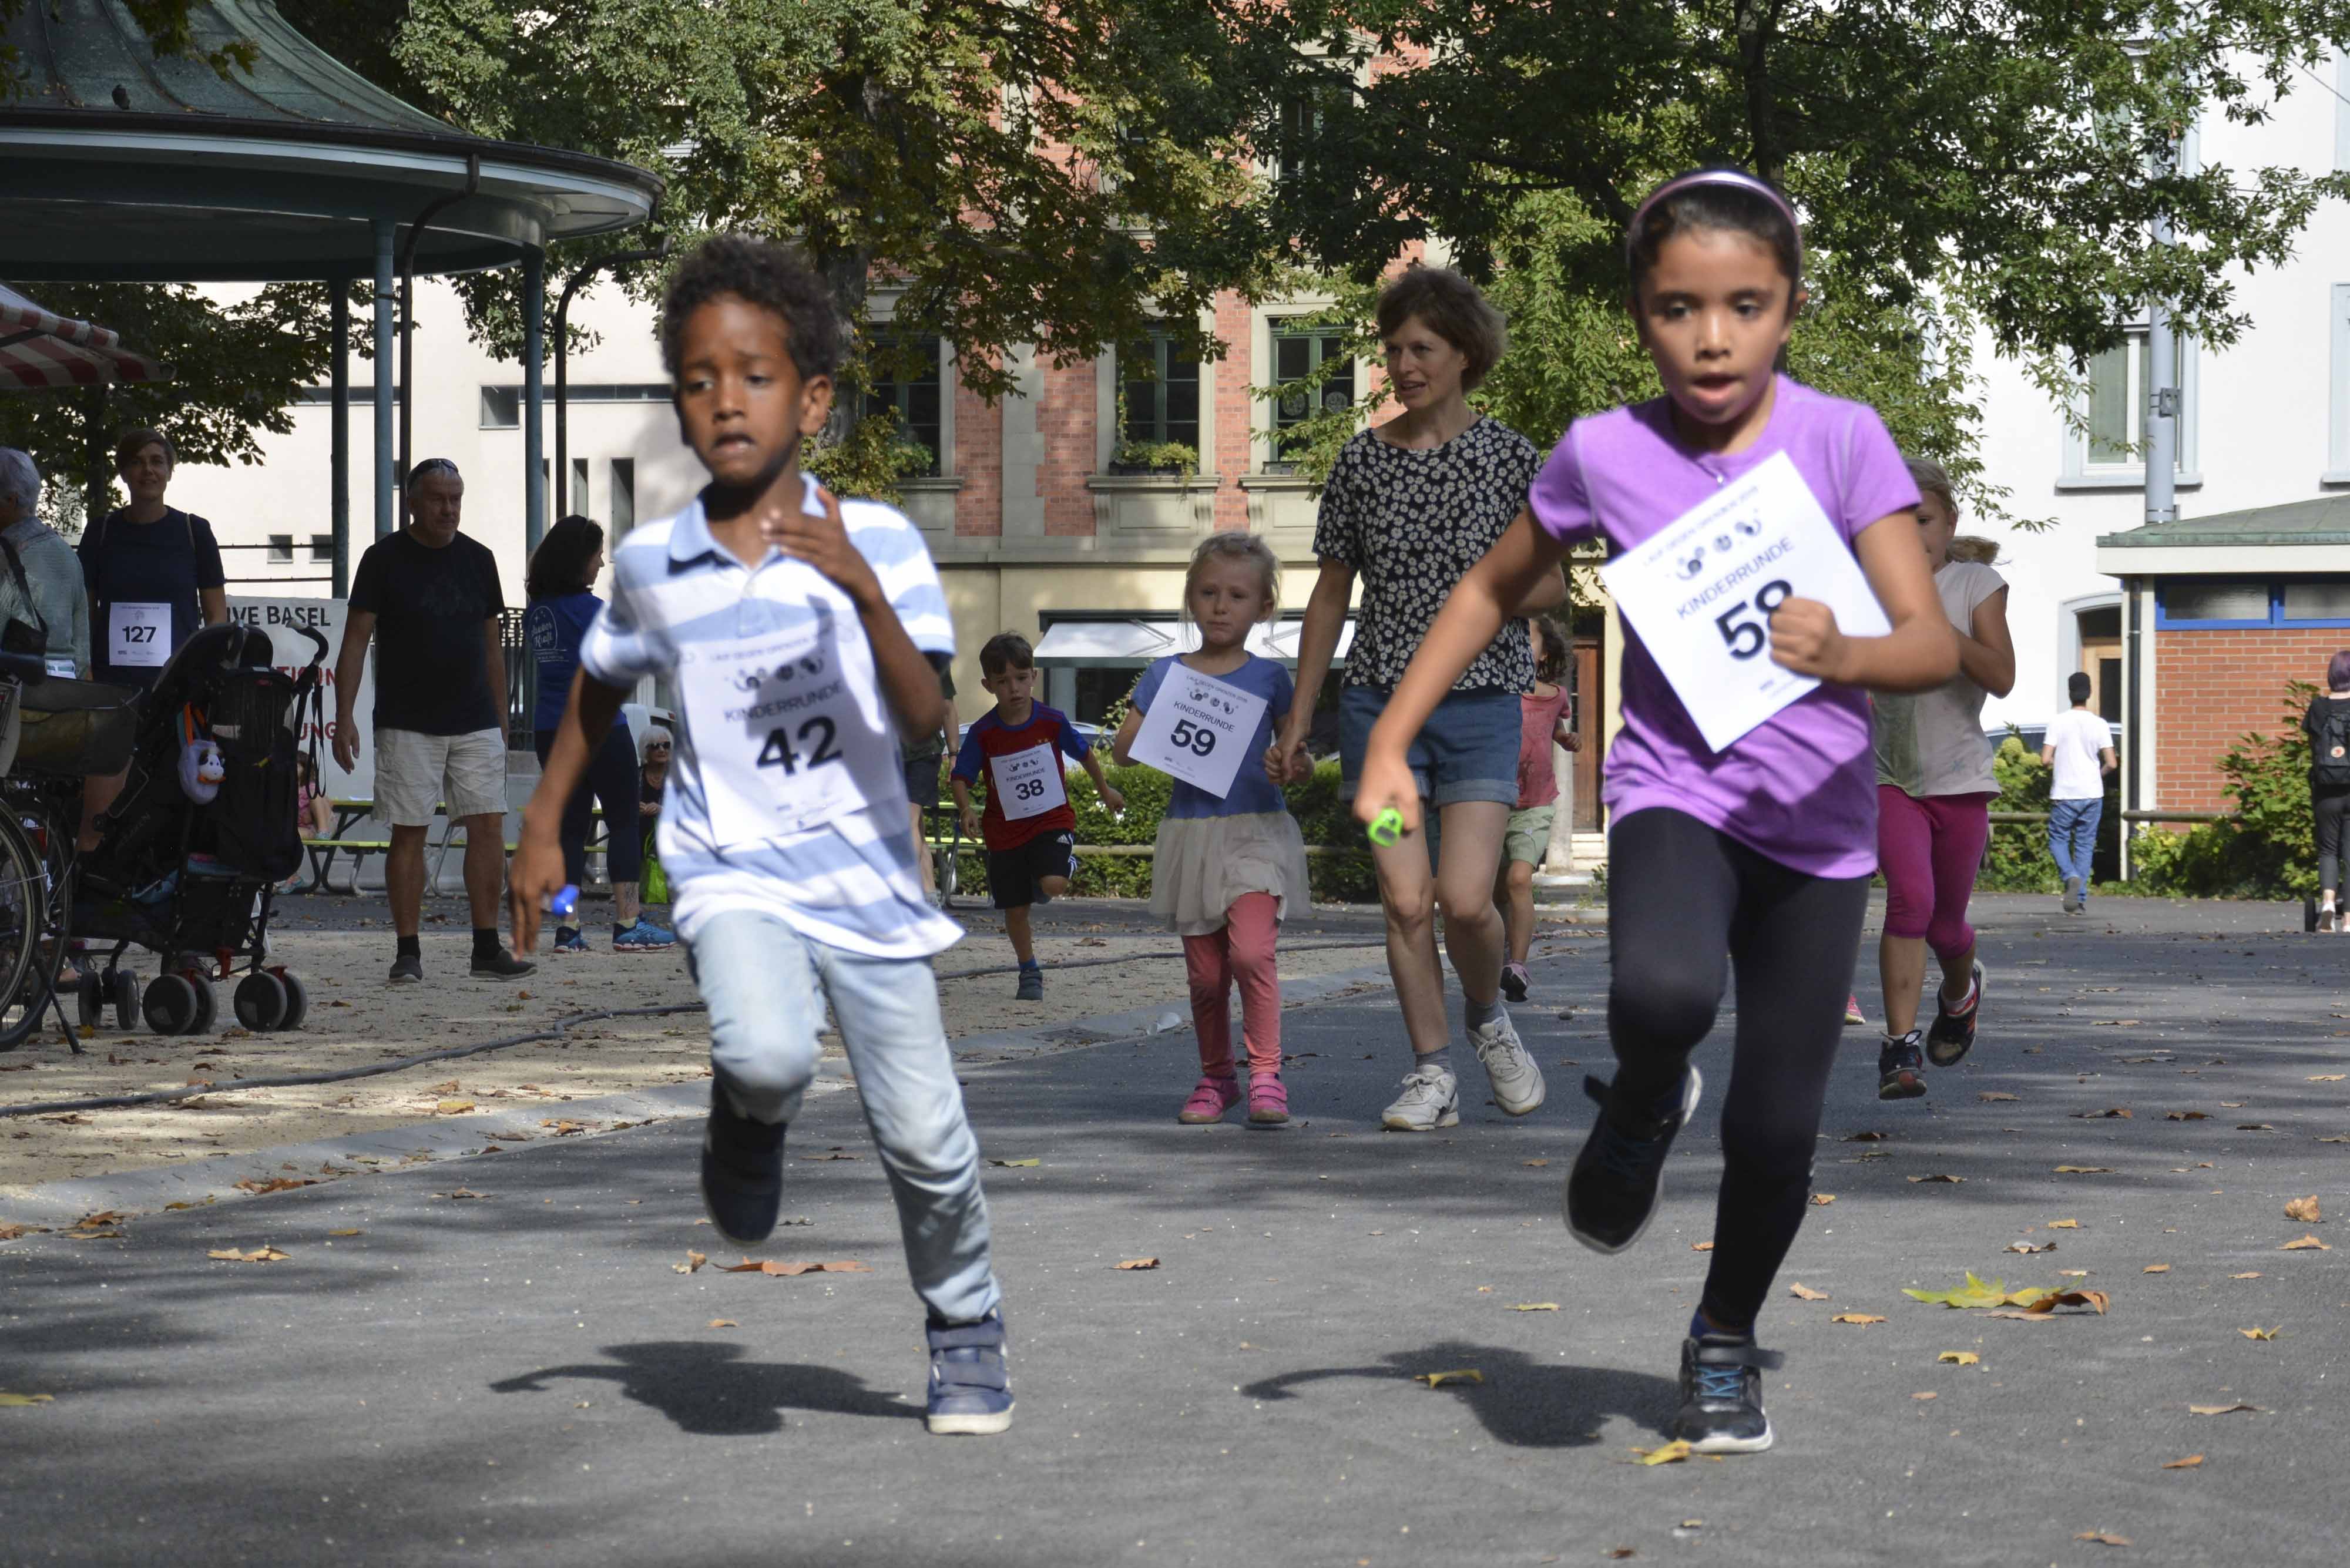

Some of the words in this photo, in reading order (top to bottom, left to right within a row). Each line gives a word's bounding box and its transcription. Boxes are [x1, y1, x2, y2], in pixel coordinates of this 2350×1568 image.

[1676, 537, 1794, 619] KINDERRUNDE
[122, 626, 157, 643] 127
[267, 606, 331, 627] BASEL
[724, 680, 841, 722] KINDERRUNDE
[1174, 700, 1236, 733] KINDERRUNDE
[757, 716, 843, 775] 42
[1171, 718, 1216, 757] 59
[1015, 779, 1045, 800] 38
